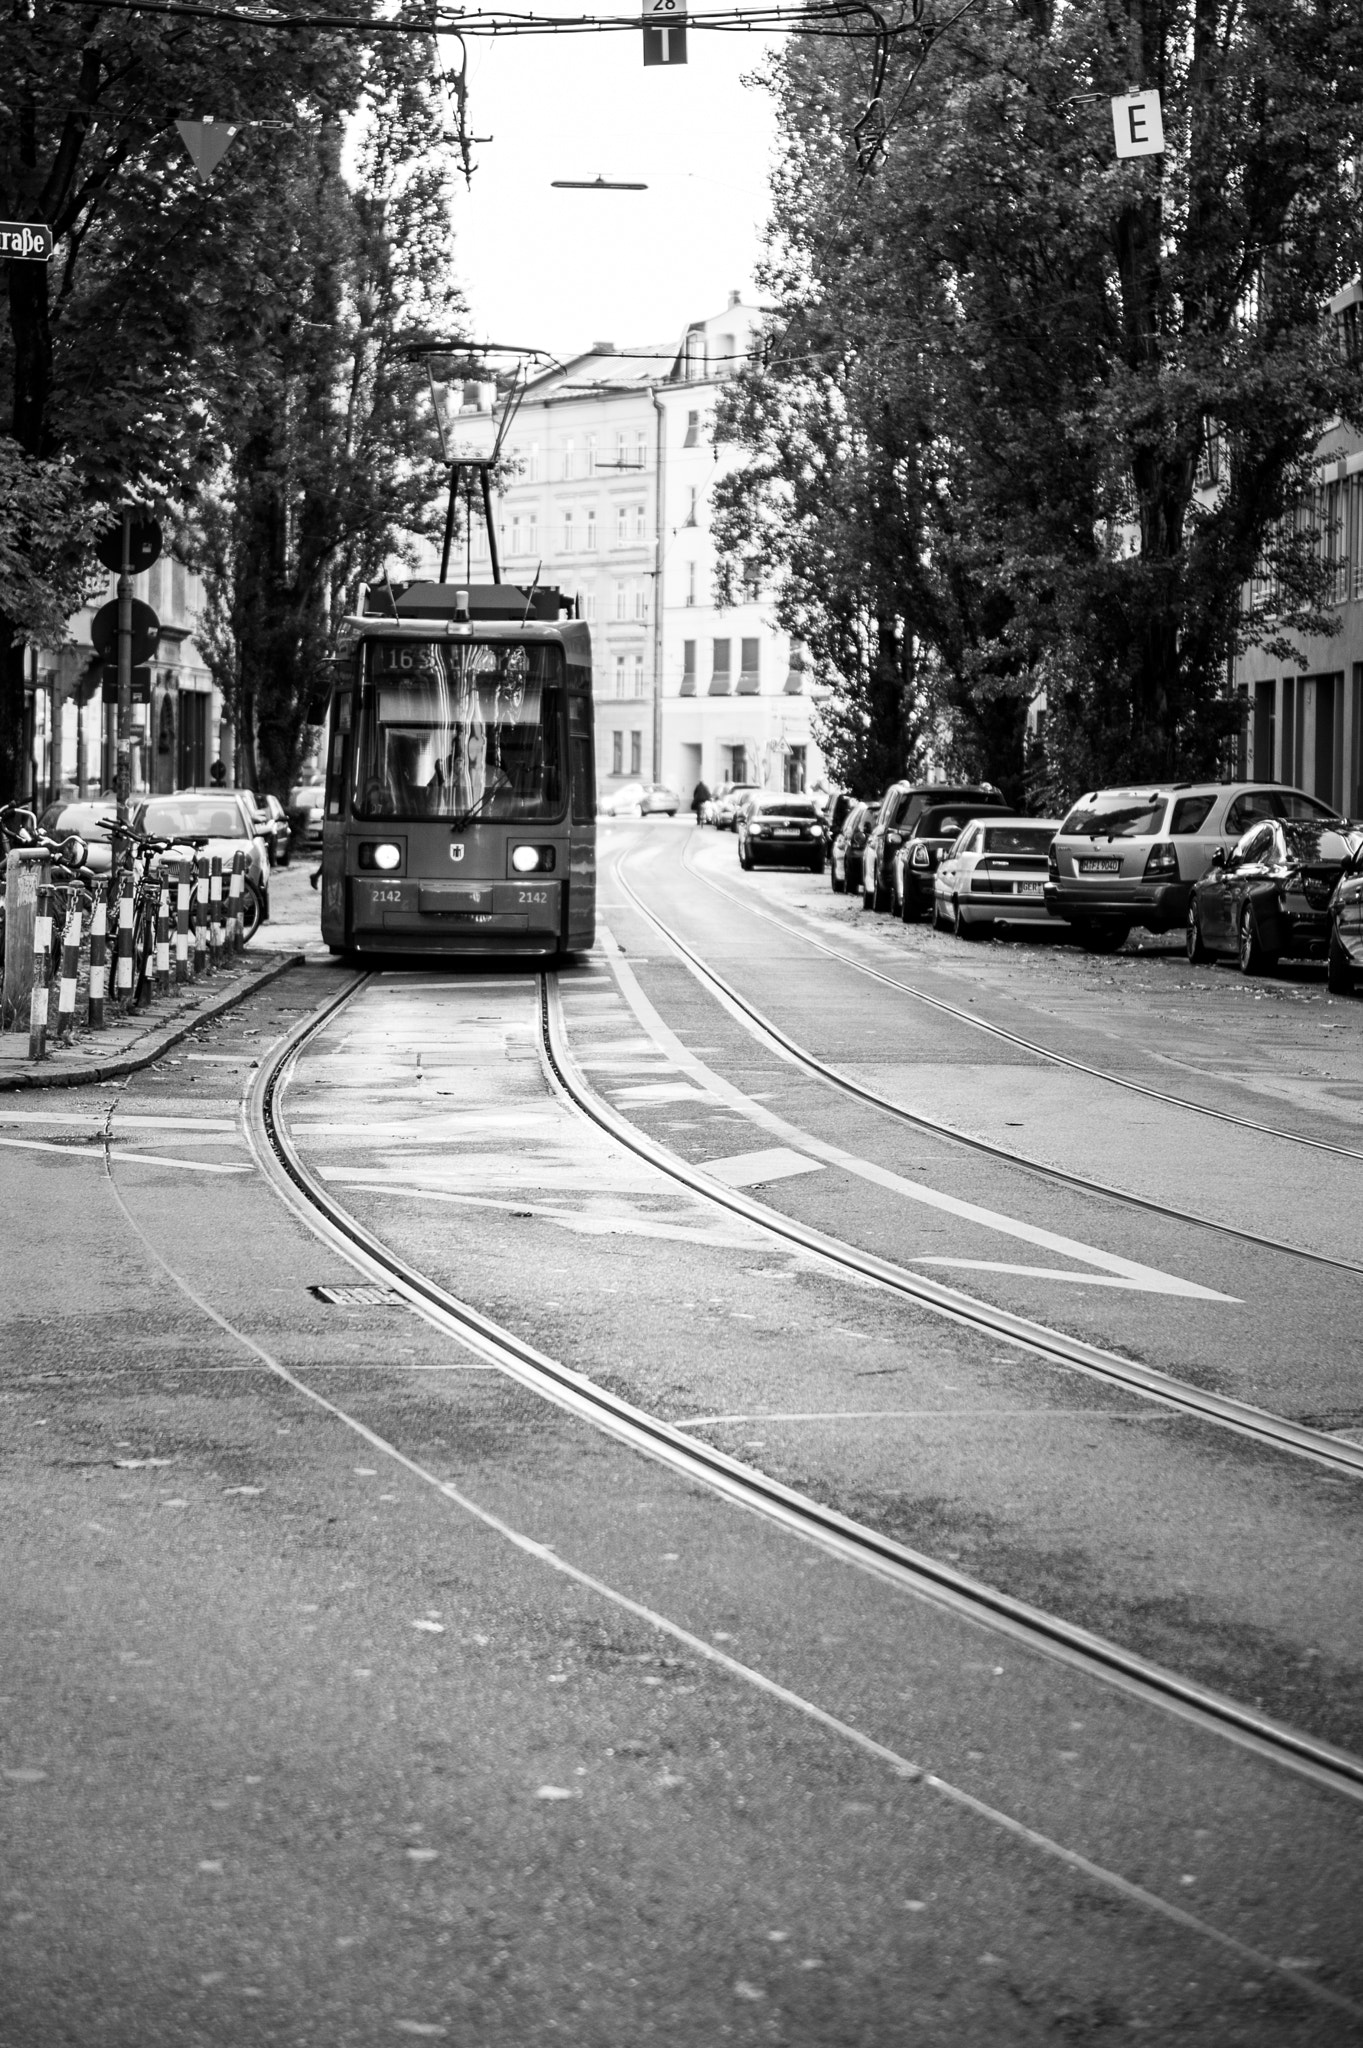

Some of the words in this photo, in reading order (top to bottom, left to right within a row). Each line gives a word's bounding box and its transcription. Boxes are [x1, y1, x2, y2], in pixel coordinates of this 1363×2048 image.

[1128, 104, 1149, 143] E
[0, 227, 45, 256] raße
[389, 648, 413, 669] 16
[372, 890, 401, 902] 2142
[519, 891, 547, 904] 2142
